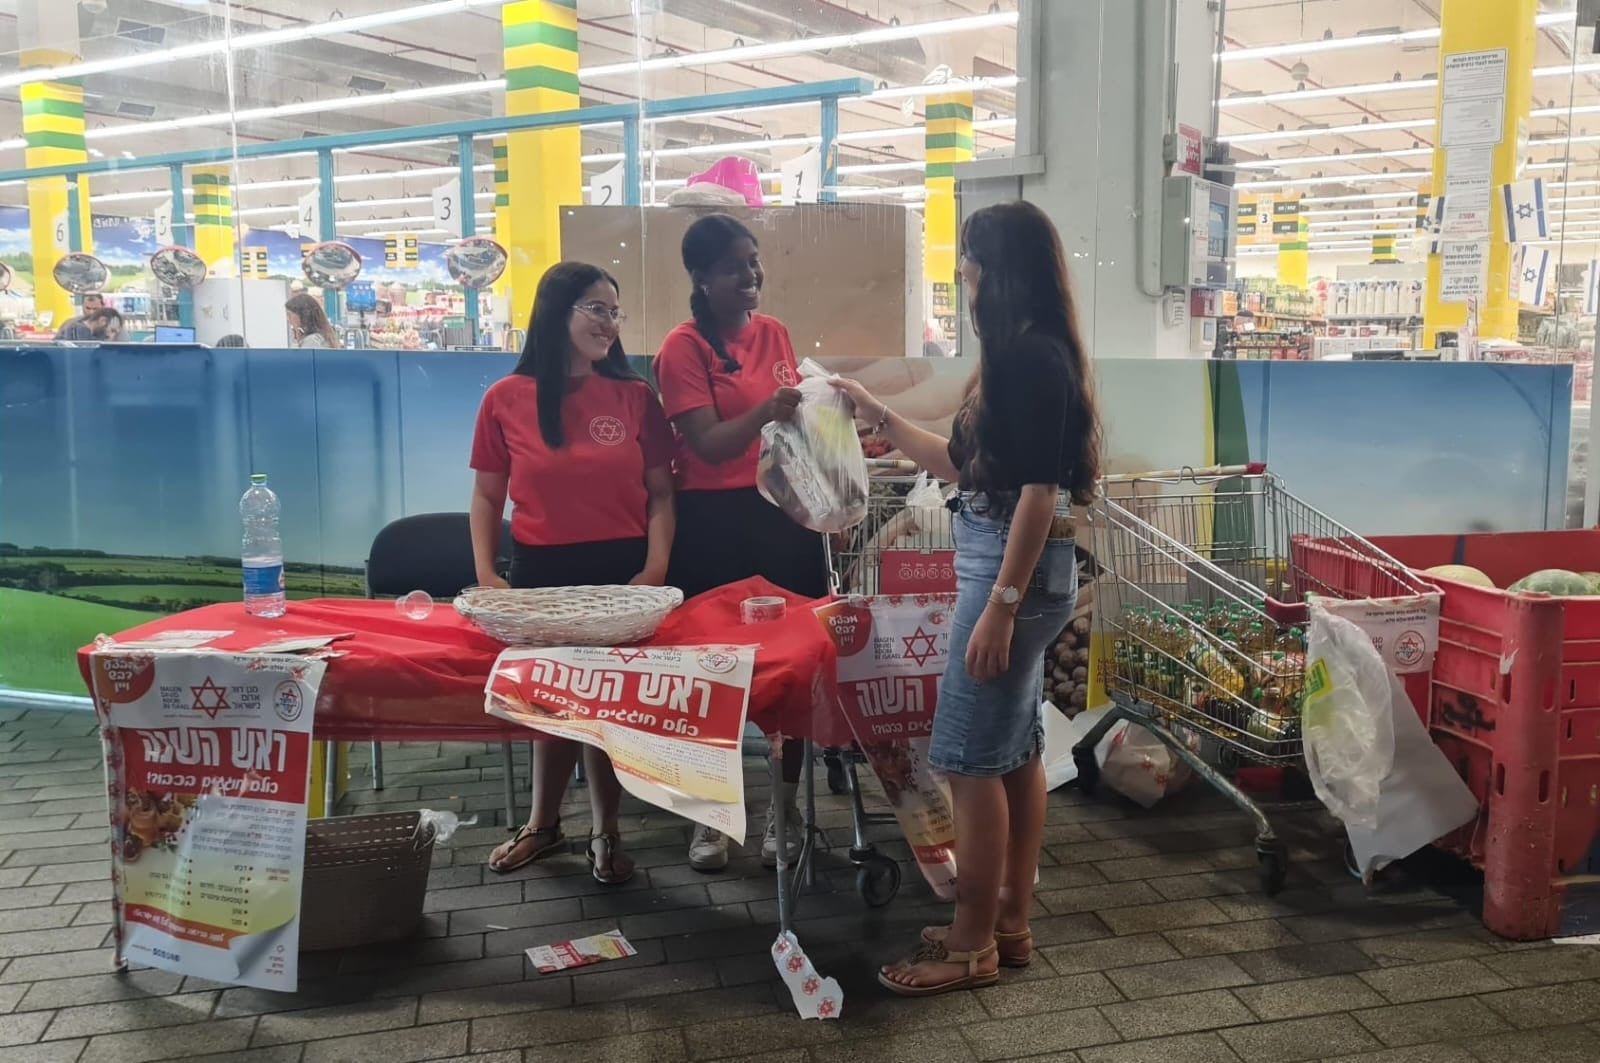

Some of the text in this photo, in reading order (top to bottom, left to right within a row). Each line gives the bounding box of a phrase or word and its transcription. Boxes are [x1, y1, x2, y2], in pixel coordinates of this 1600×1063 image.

[601, 185, 612, 205] 2
[792, 170, 803, 199] 1
[303, 206, 313, 229] 4
[440, 197, 452, 220] 3
[1261, 213, 1268, 224] 3
[56, 223, 64, 242] 6
[159, 215, 167, 236] 5
[531, 659, 711, 718] ראש השנה
[855, 677, 924, 717] השנה
[596, 708, 657, 727] חוגגים
[663, 718, 699, 736] כולם
[136, 728, 286, 772] ראש השנה
